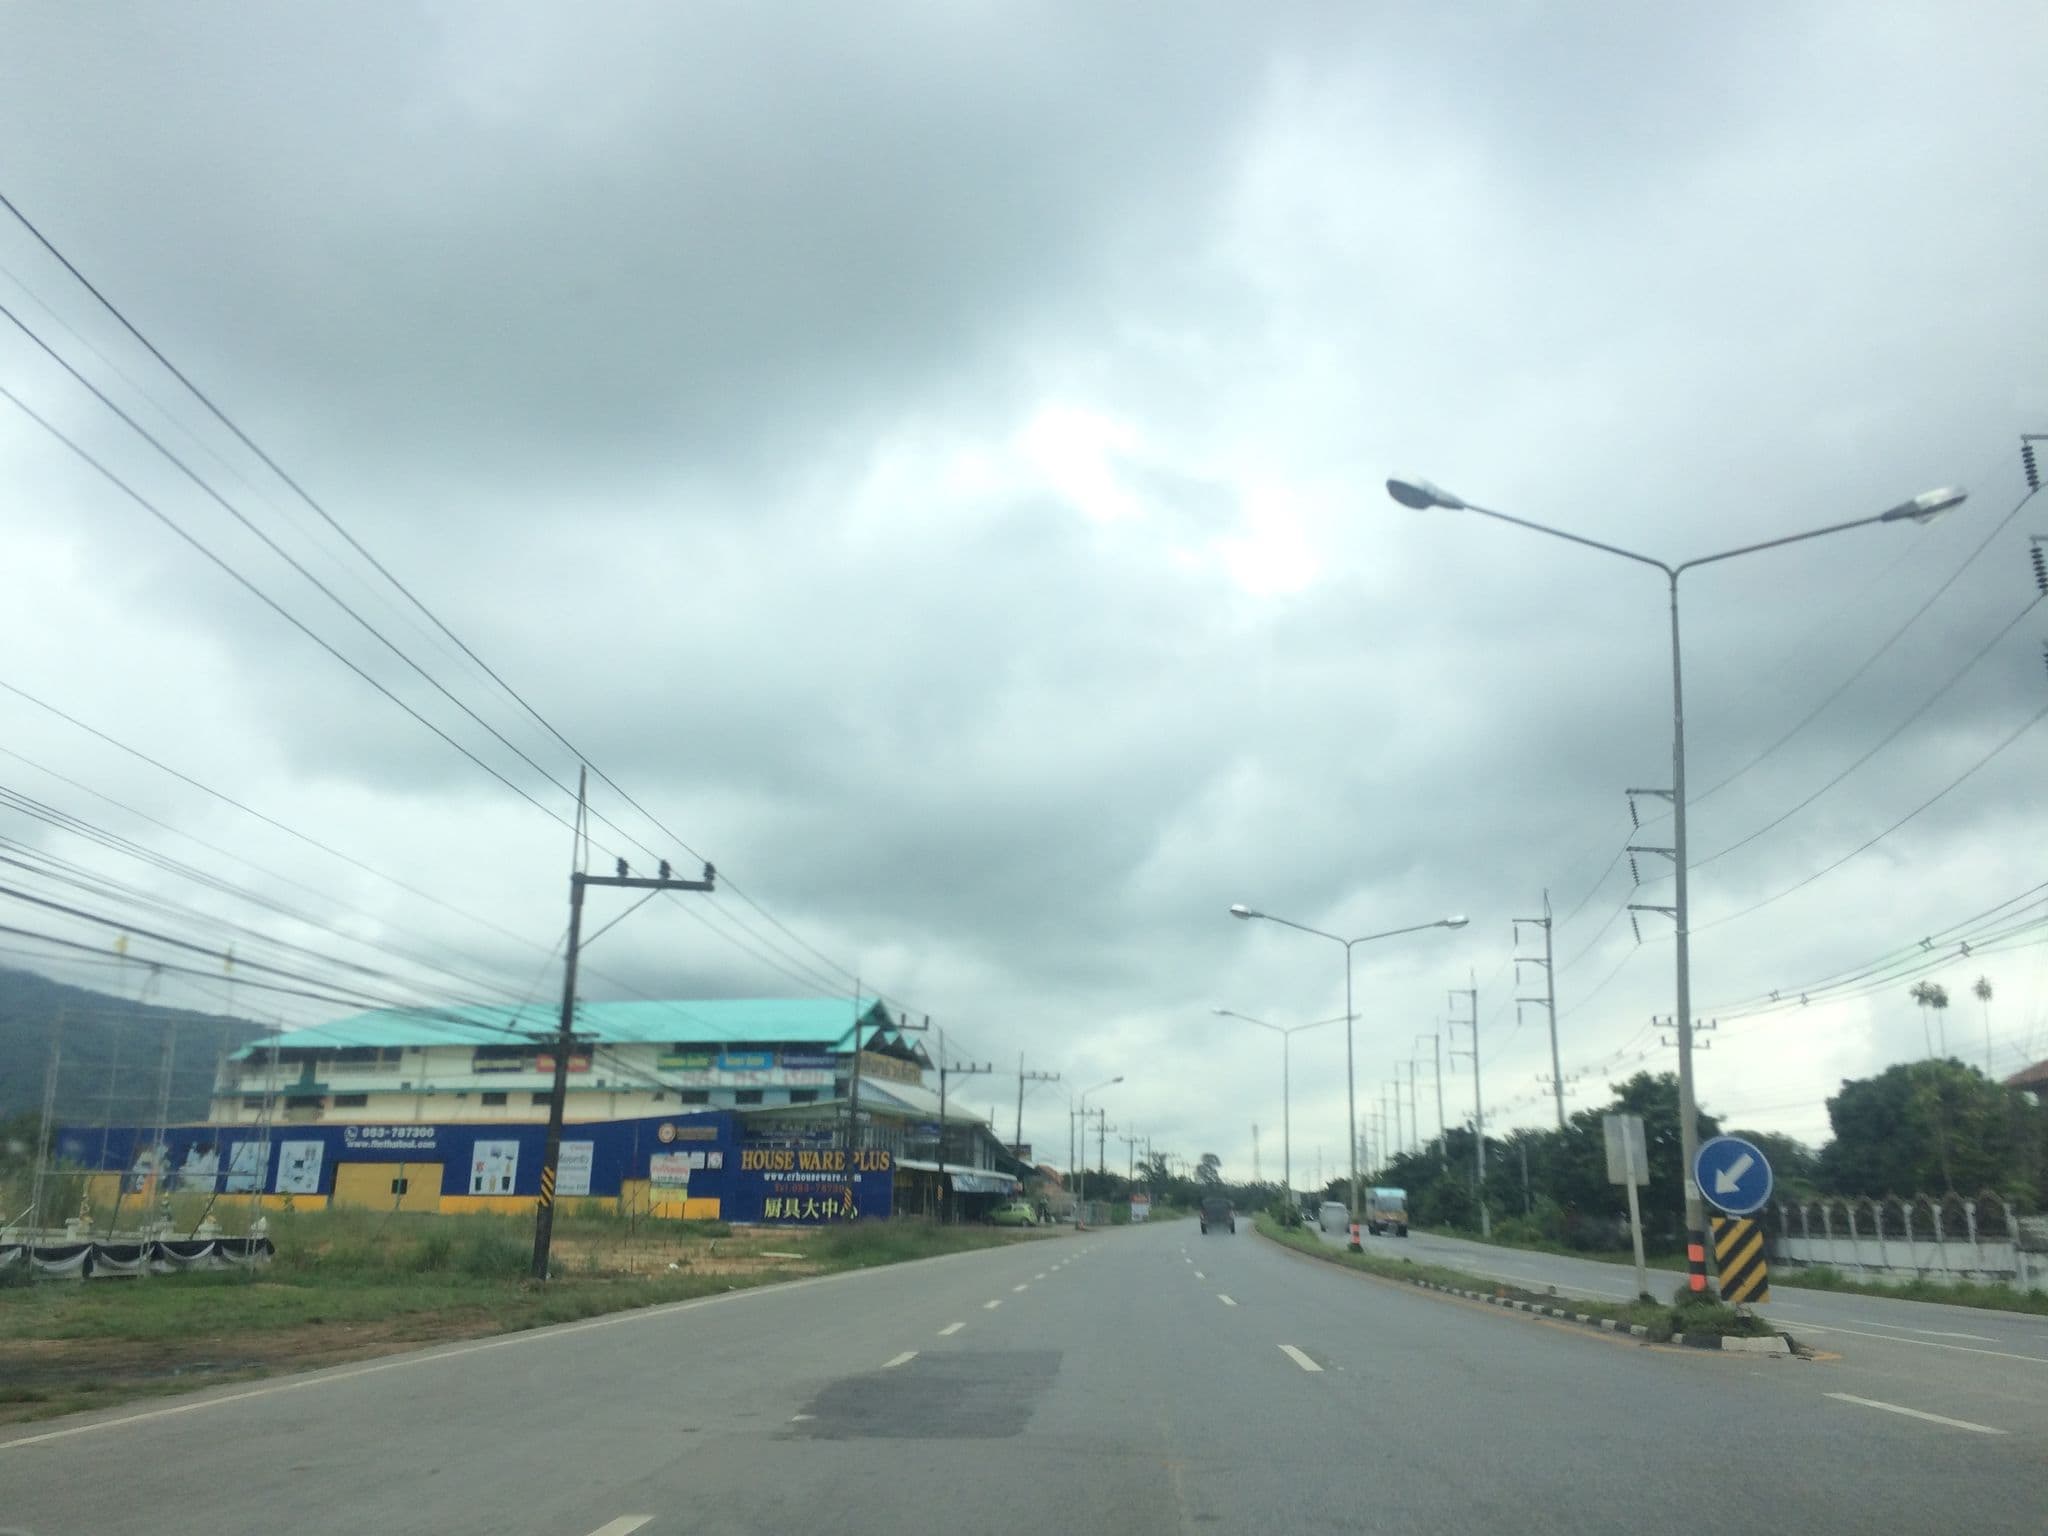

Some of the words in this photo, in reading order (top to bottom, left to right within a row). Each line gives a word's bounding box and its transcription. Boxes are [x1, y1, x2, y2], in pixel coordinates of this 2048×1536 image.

[741, 1150, 794, 1171] HOUSE
[799, 1150, 846, 1171] WARE
[764, 1173, 862, 1183] www.crhouseware.cm
